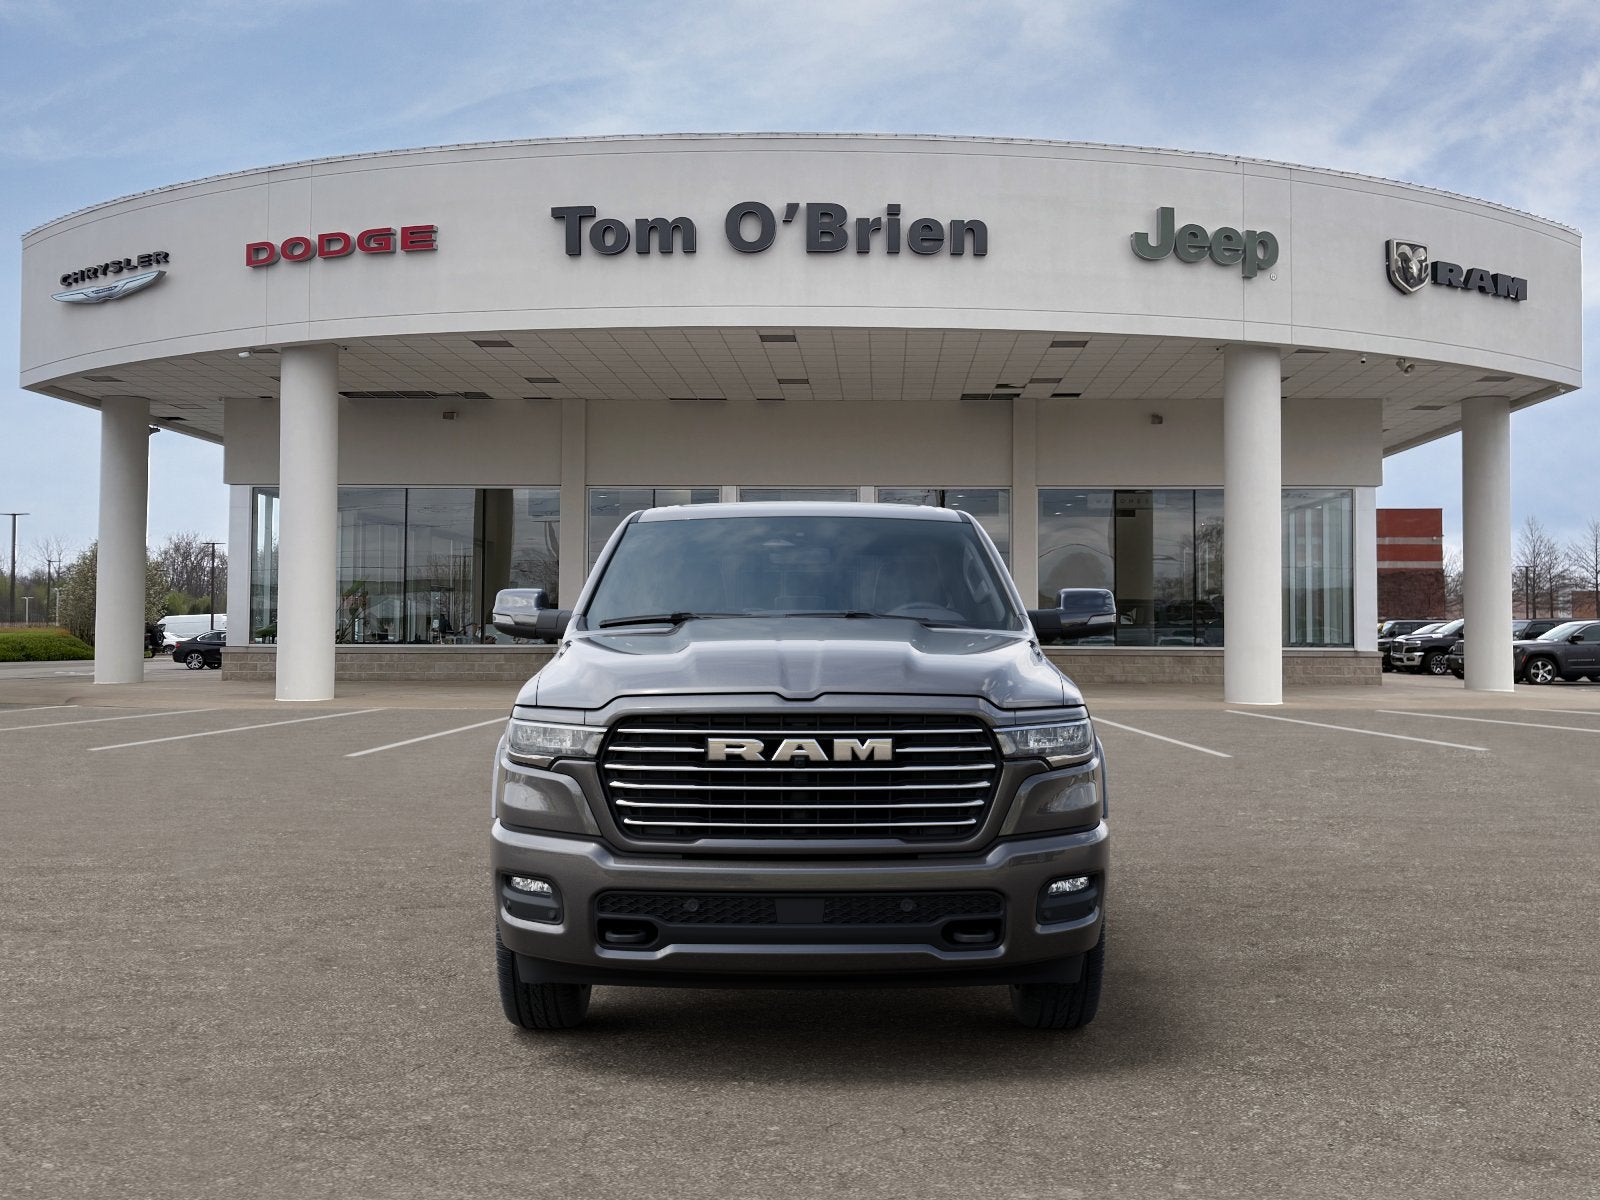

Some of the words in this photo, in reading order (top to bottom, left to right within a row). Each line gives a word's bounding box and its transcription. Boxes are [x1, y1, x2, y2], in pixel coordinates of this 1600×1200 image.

[245, 225, 438, 269] DODGE
[550, 205, 697, 256] Tom
[725, 201, 988, 256] O'Brien
[1130, 206, 1280, 279] Jeep
[60, 250, 170, 287] CHRYSLER
[1431, 260, 1528, 301] RAM
[707, 737, 893, 761] RAM
